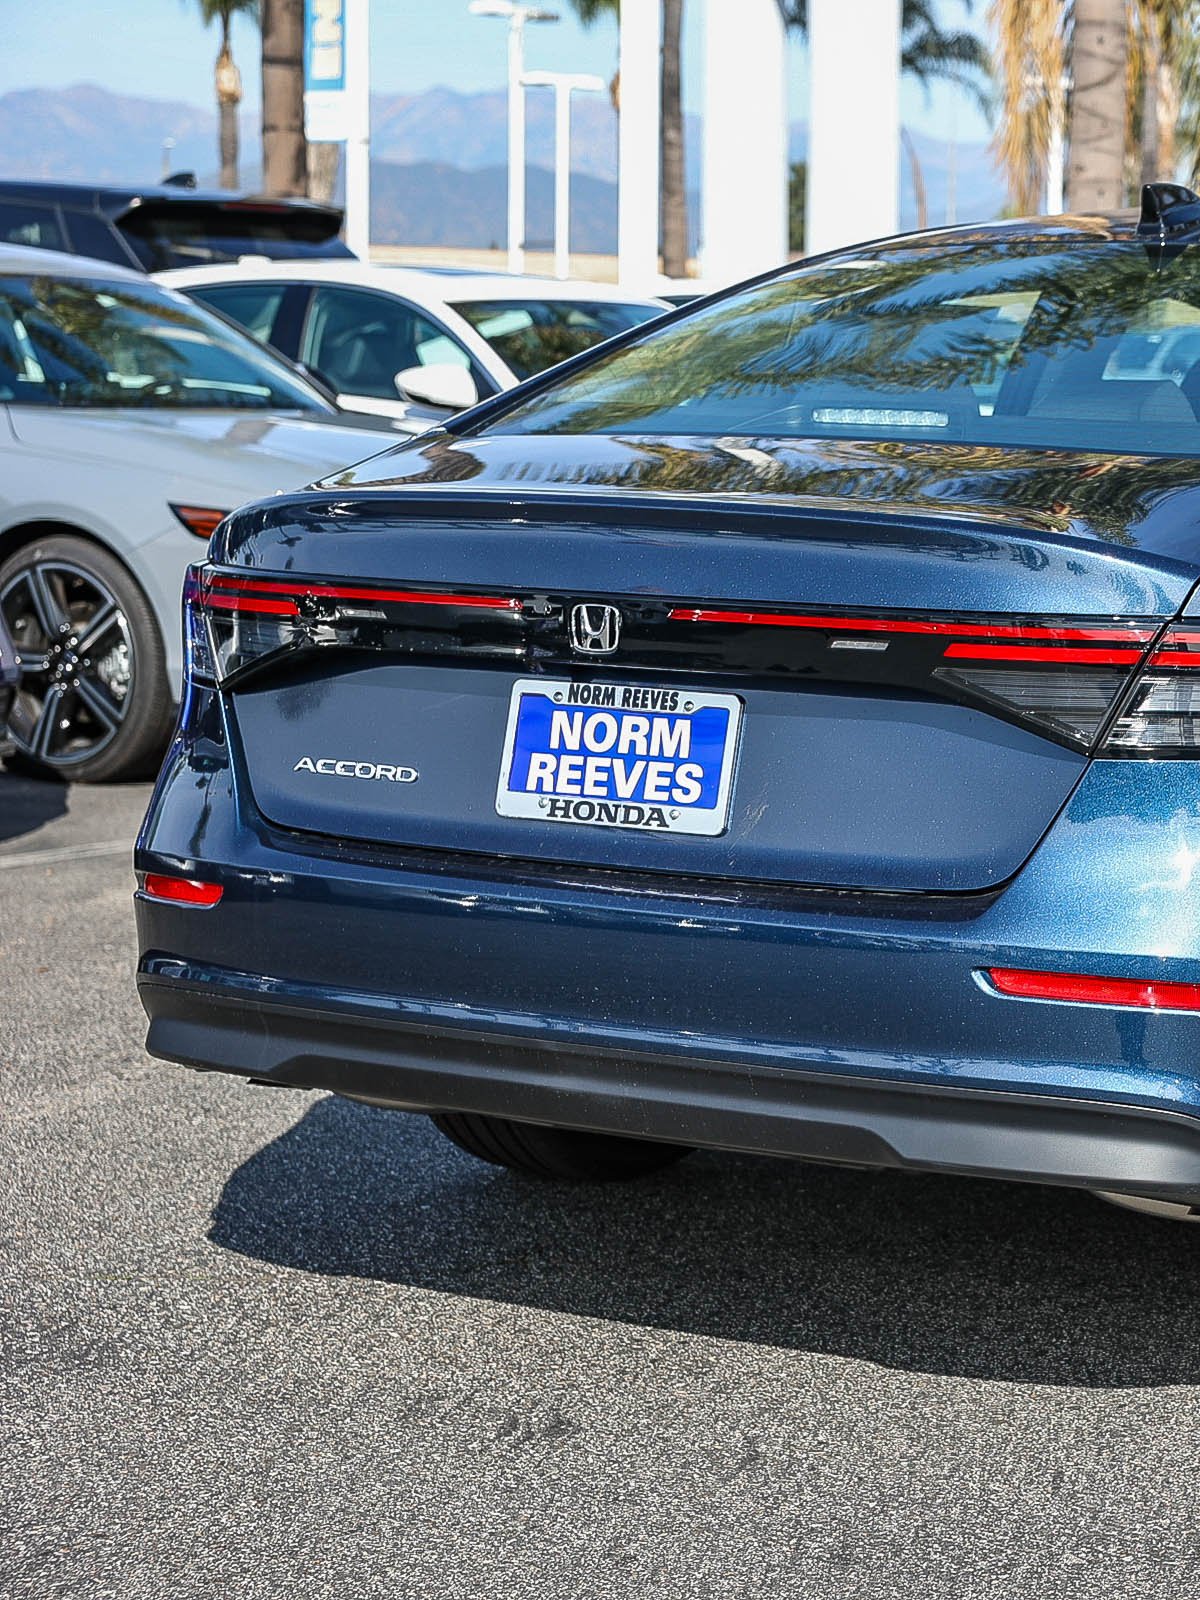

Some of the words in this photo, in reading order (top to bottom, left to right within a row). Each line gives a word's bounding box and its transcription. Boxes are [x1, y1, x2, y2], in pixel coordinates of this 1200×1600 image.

[567, 683, 617, 707] NORM
[622, 688, 680, 712] REEVES
[550, 710, 692, 759] NORM
[293, 756, 418, 783] ACCORD
[526, 752, 705, 804] REEVES
[546, 799, 669, 828] HONDA
